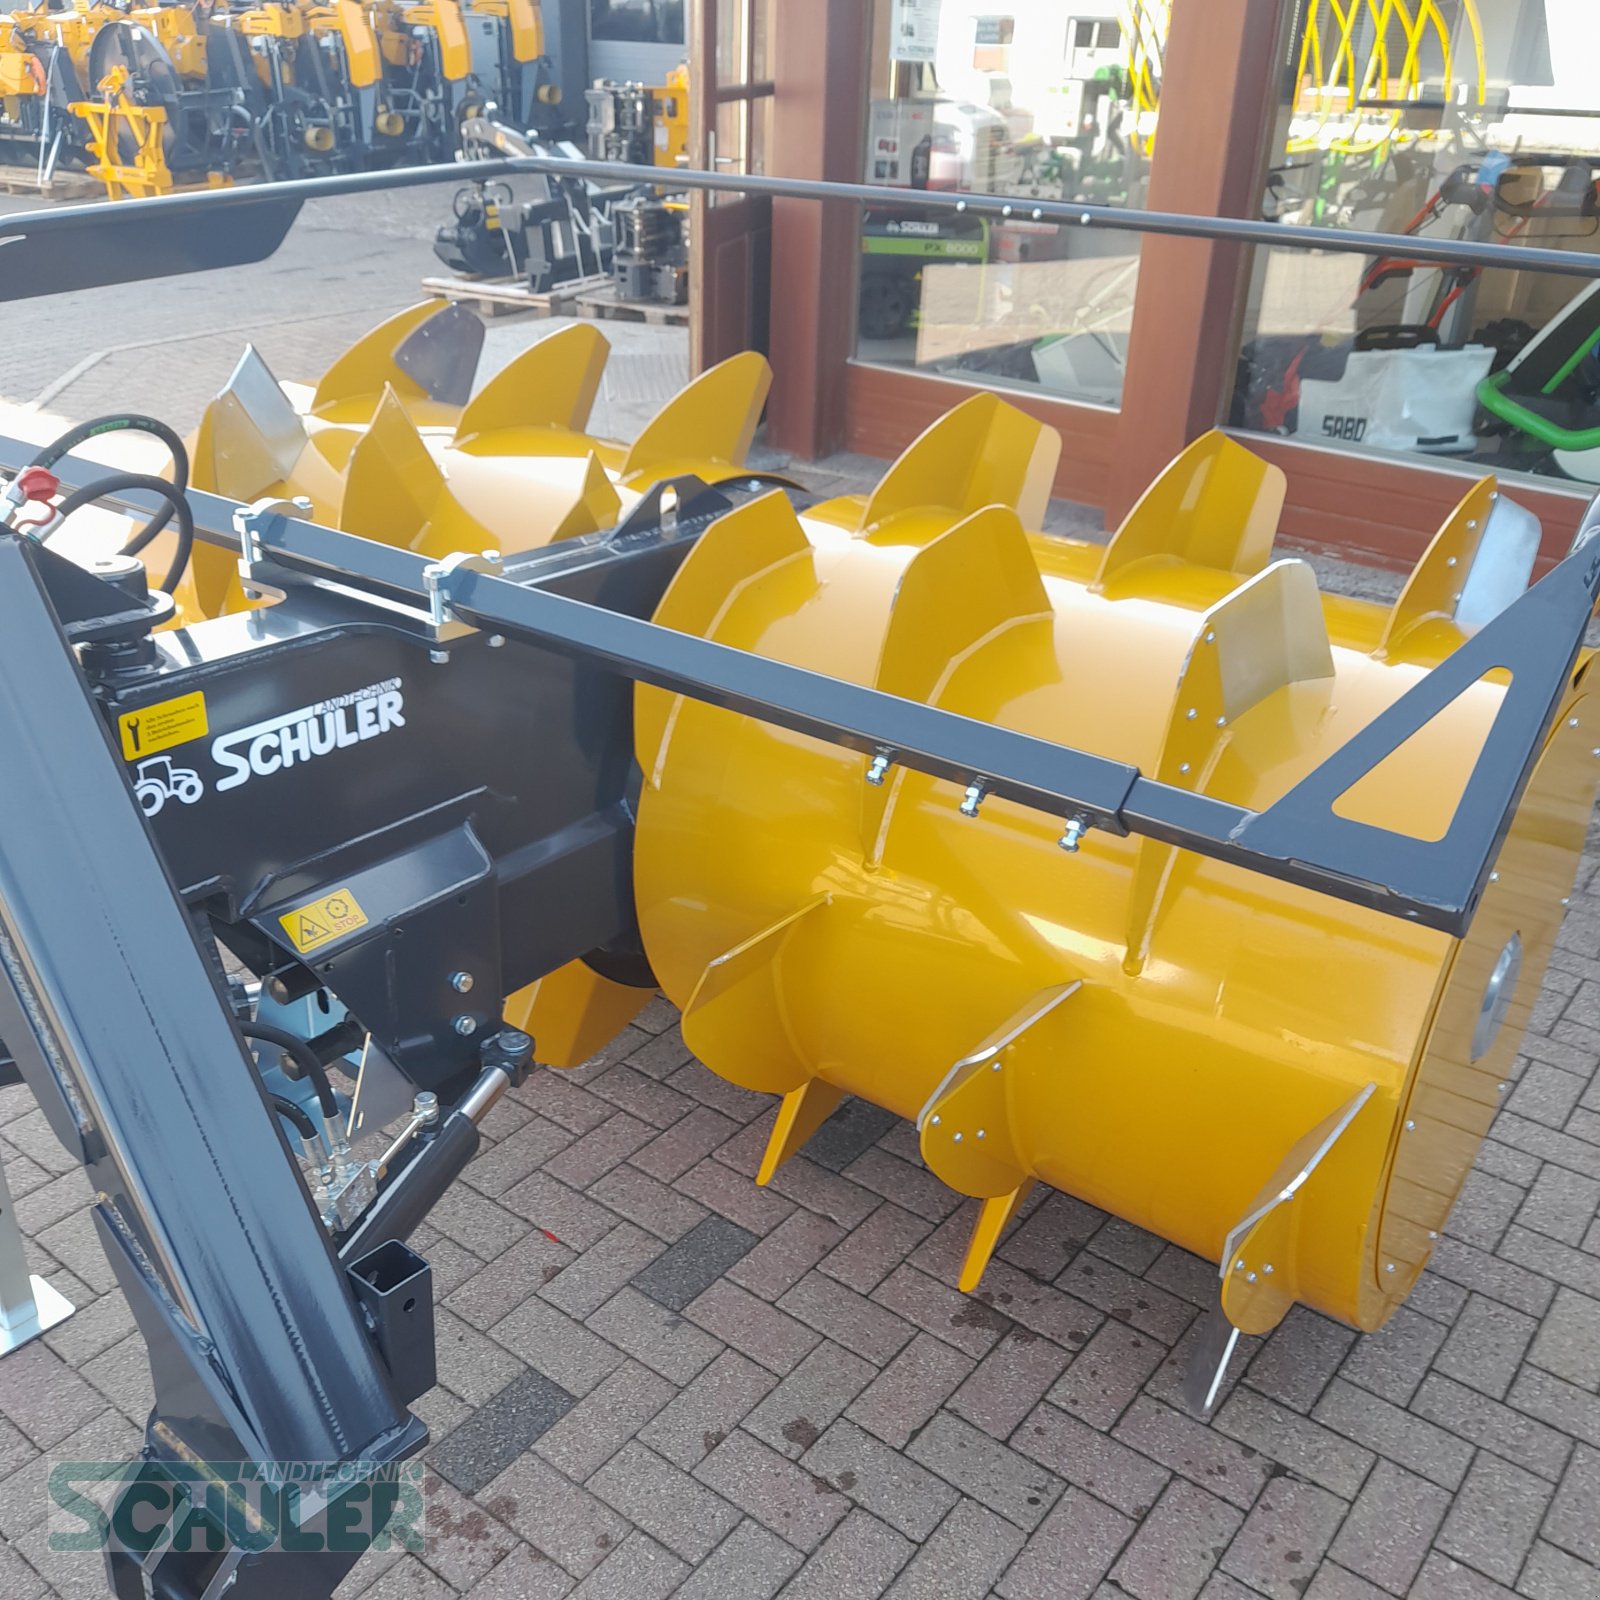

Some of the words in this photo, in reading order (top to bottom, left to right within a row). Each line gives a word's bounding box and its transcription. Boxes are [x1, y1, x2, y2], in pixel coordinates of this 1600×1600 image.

[1321, 415, 1368, 442] SABO
[313, 677, 402, 715] LANDTECHNIK
[211, 690, 406, 792] SCHULER
[333, 914, 360, 931] STOP
